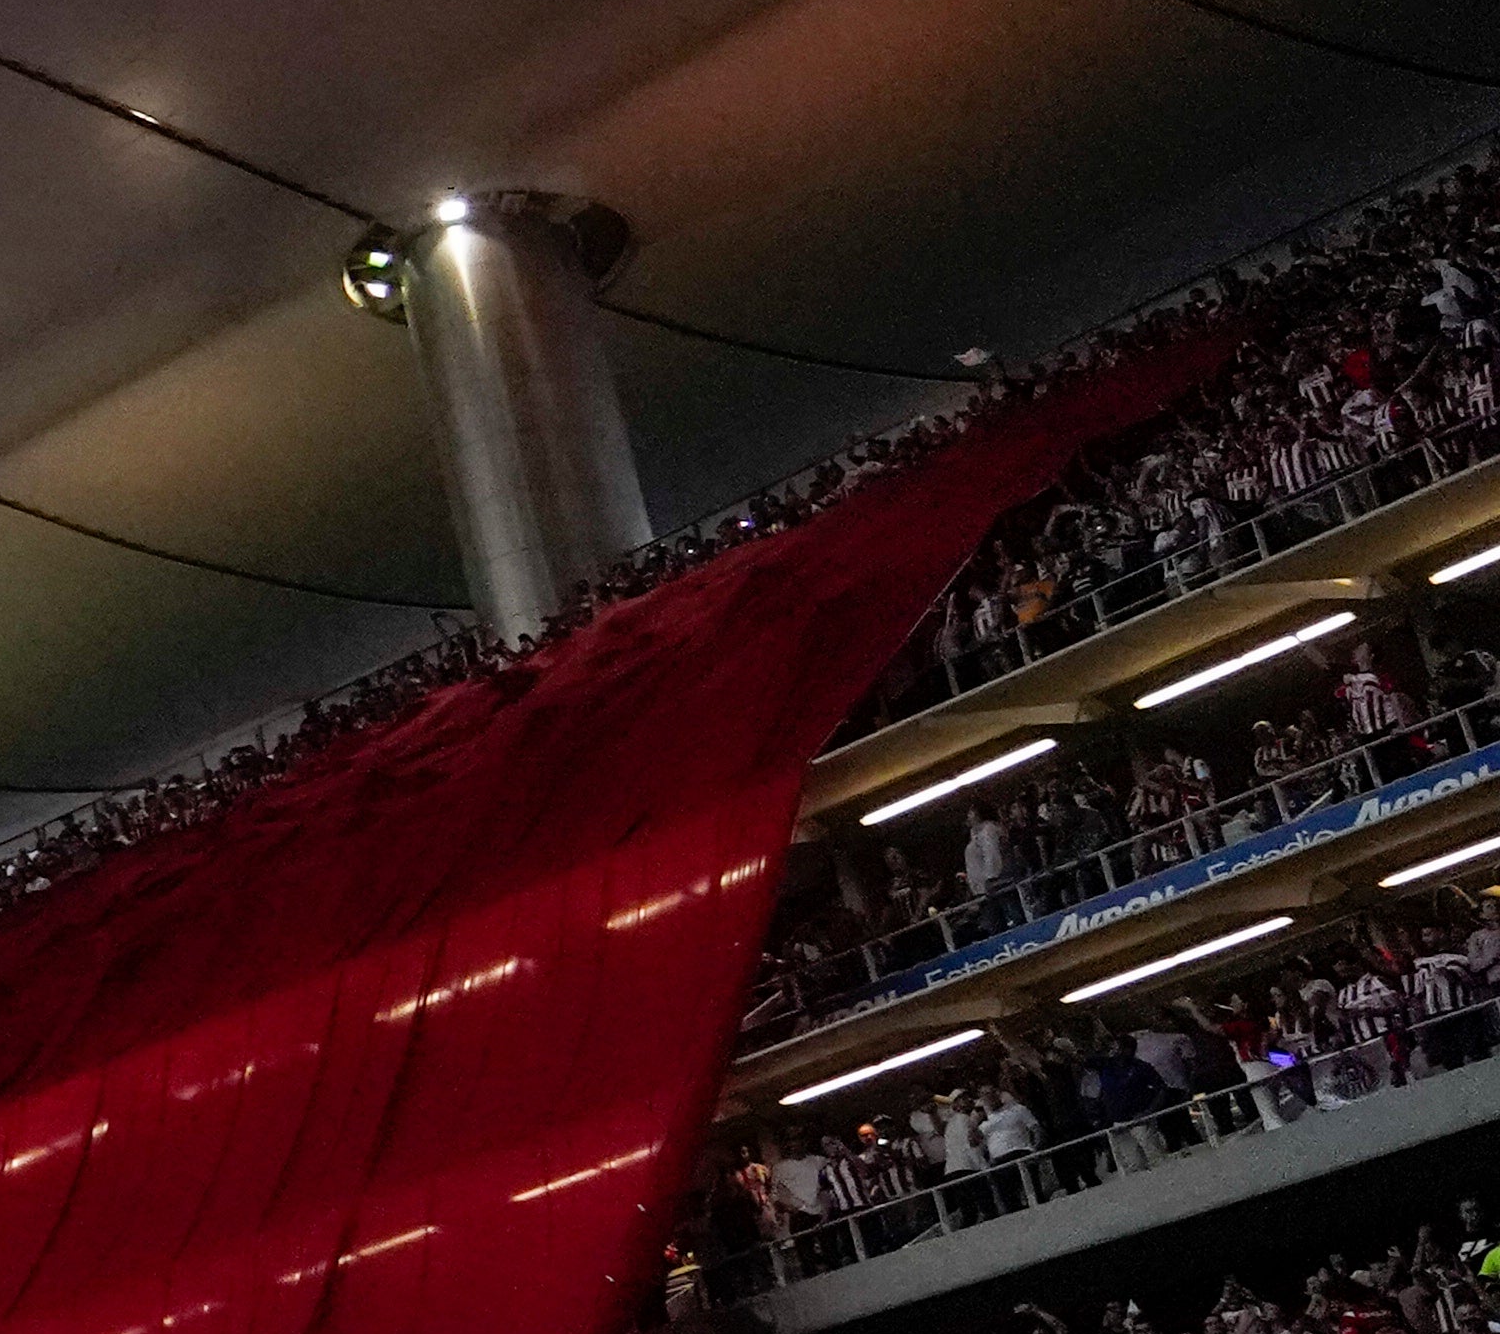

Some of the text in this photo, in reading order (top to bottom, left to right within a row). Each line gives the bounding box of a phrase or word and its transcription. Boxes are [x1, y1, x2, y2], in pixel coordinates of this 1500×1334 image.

[925, 940, 1041, 988] Estadio
[1055, 884, 1177, 940] AKRON
[1206, 829, 1338, 882] Estadio
[1353, 762, 1491, 829] AKRON
